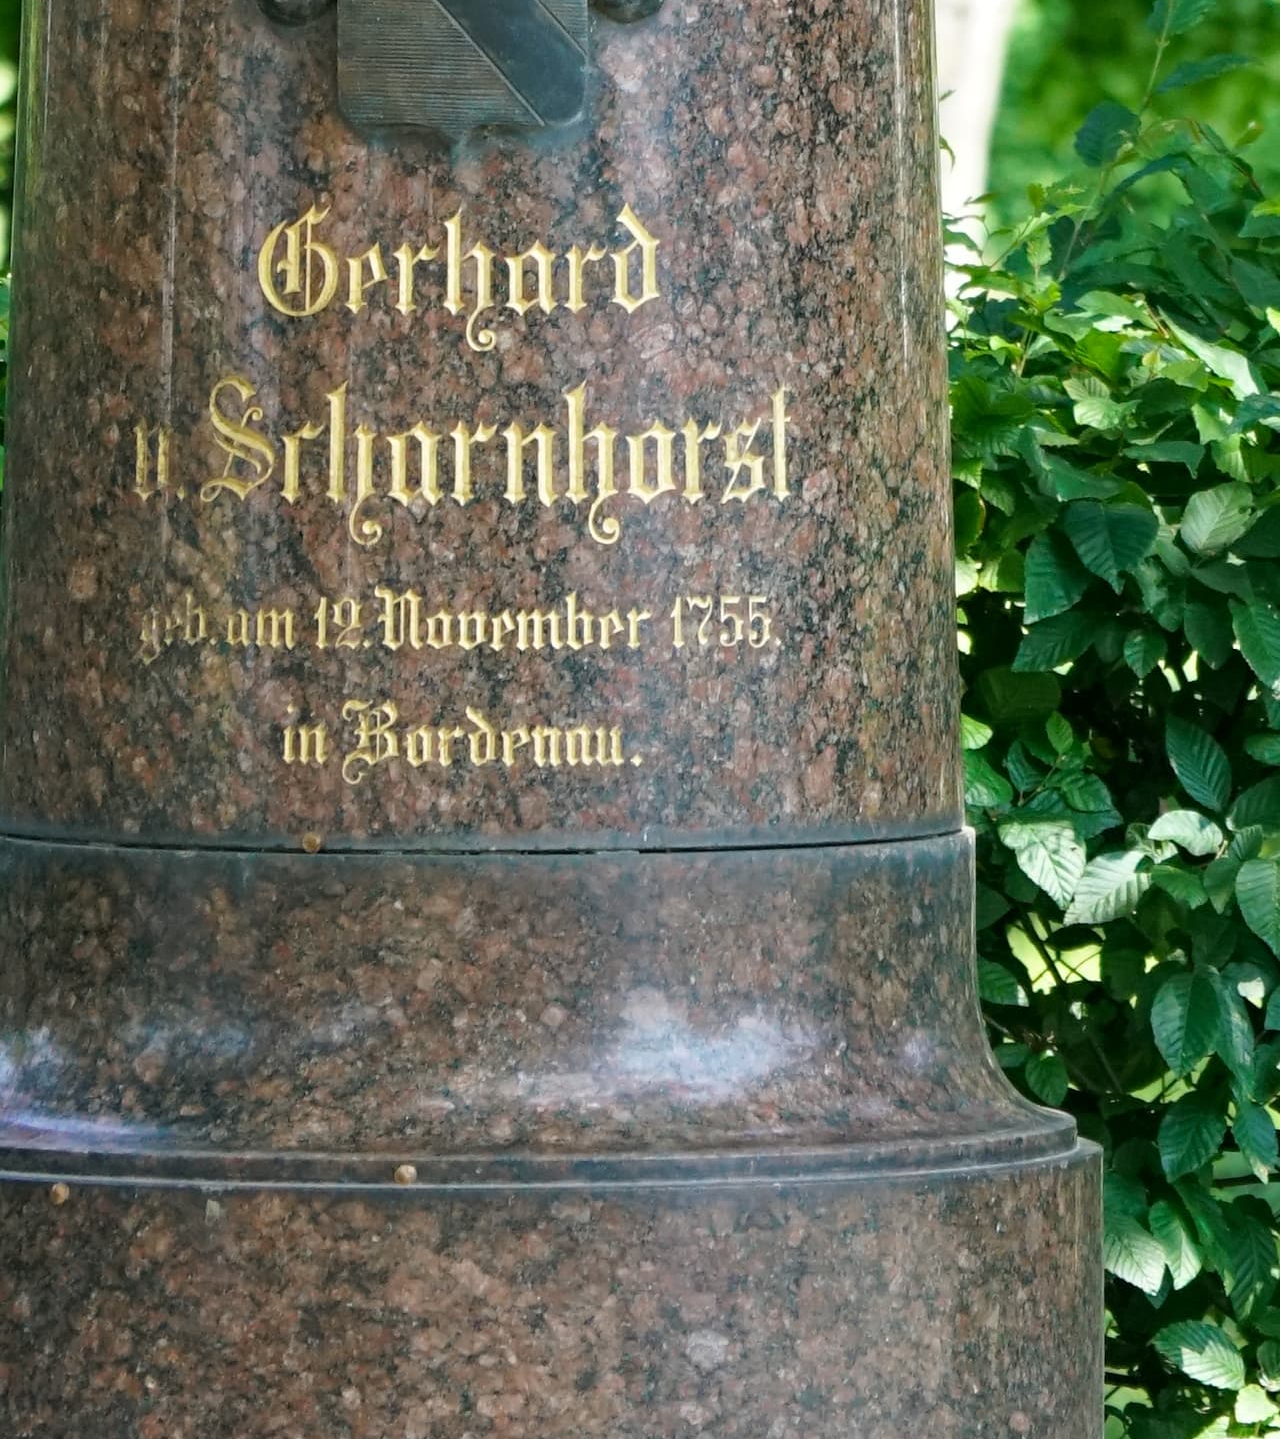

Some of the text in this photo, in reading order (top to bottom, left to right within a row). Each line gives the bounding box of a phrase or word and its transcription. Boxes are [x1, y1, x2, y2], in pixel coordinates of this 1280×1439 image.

[257, 203, 661, 352] Gerhard
[199, 375, 794, 546] Scharnhorst
[226, 608, 297, 651] am
[373, 585, 652, 652] November
[670, 595, 782, 650] 1755.
[283, 699, 644, 785] in Bordenau.
